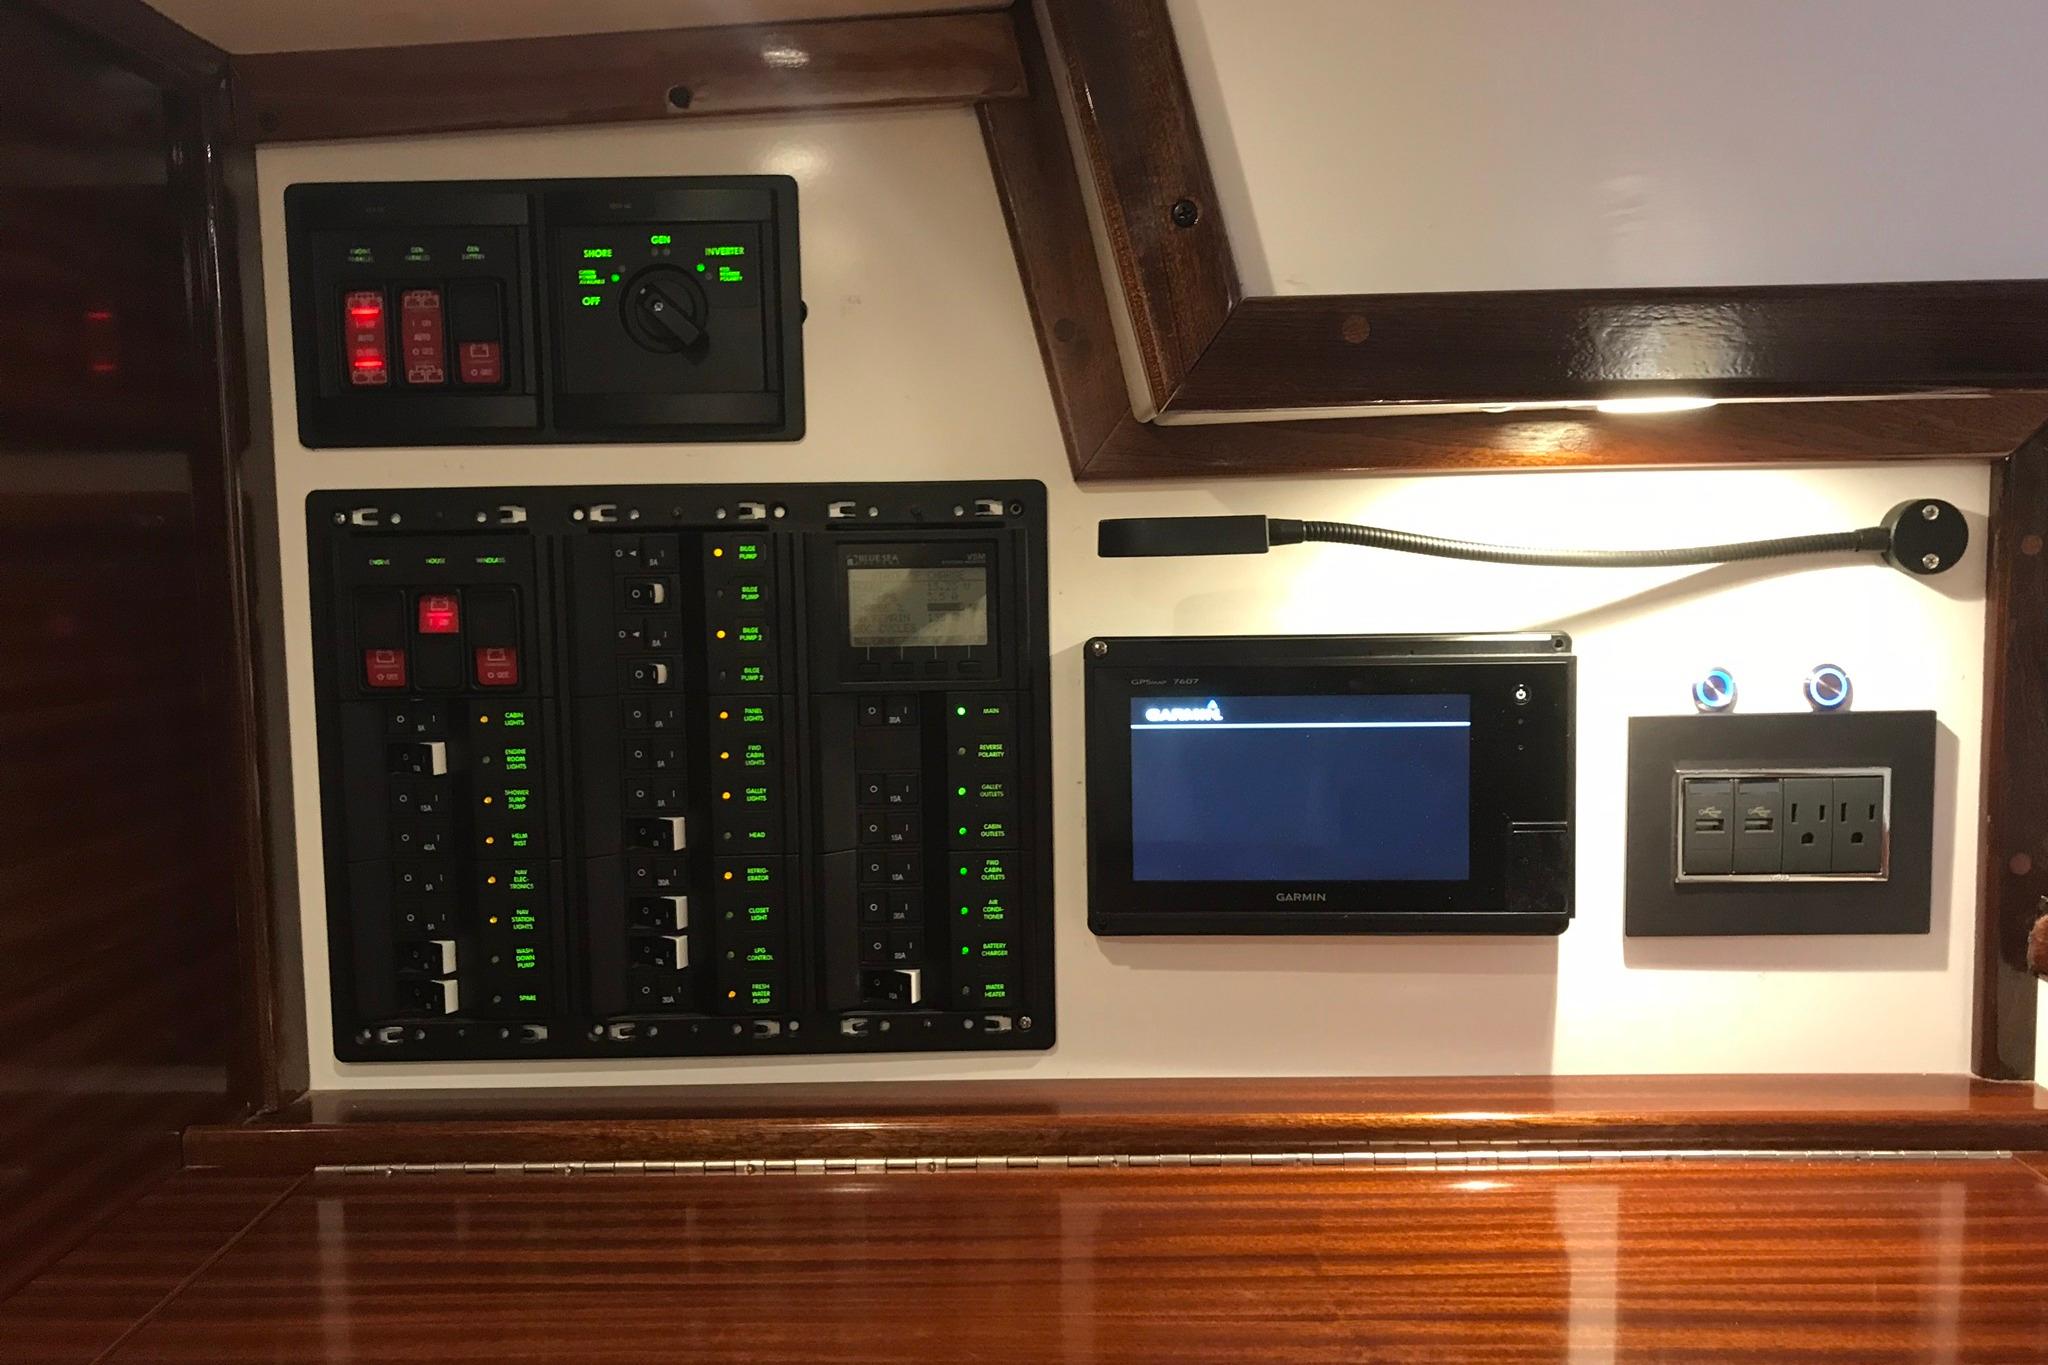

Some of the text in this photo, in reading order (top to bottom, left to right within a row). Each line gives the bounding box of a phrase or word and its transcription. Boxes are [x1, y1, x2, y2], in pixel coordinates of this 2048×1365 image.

[650, 235, 671, 245] GEN
[583, 248, 613, 258] SHORE
[704, 246, 745, 256] INVERTER
[581, 296, 601, 306] OFF
[1276, 892, 1326, 902] GARMIN
[752, 997, 770, 1005] PUMP
